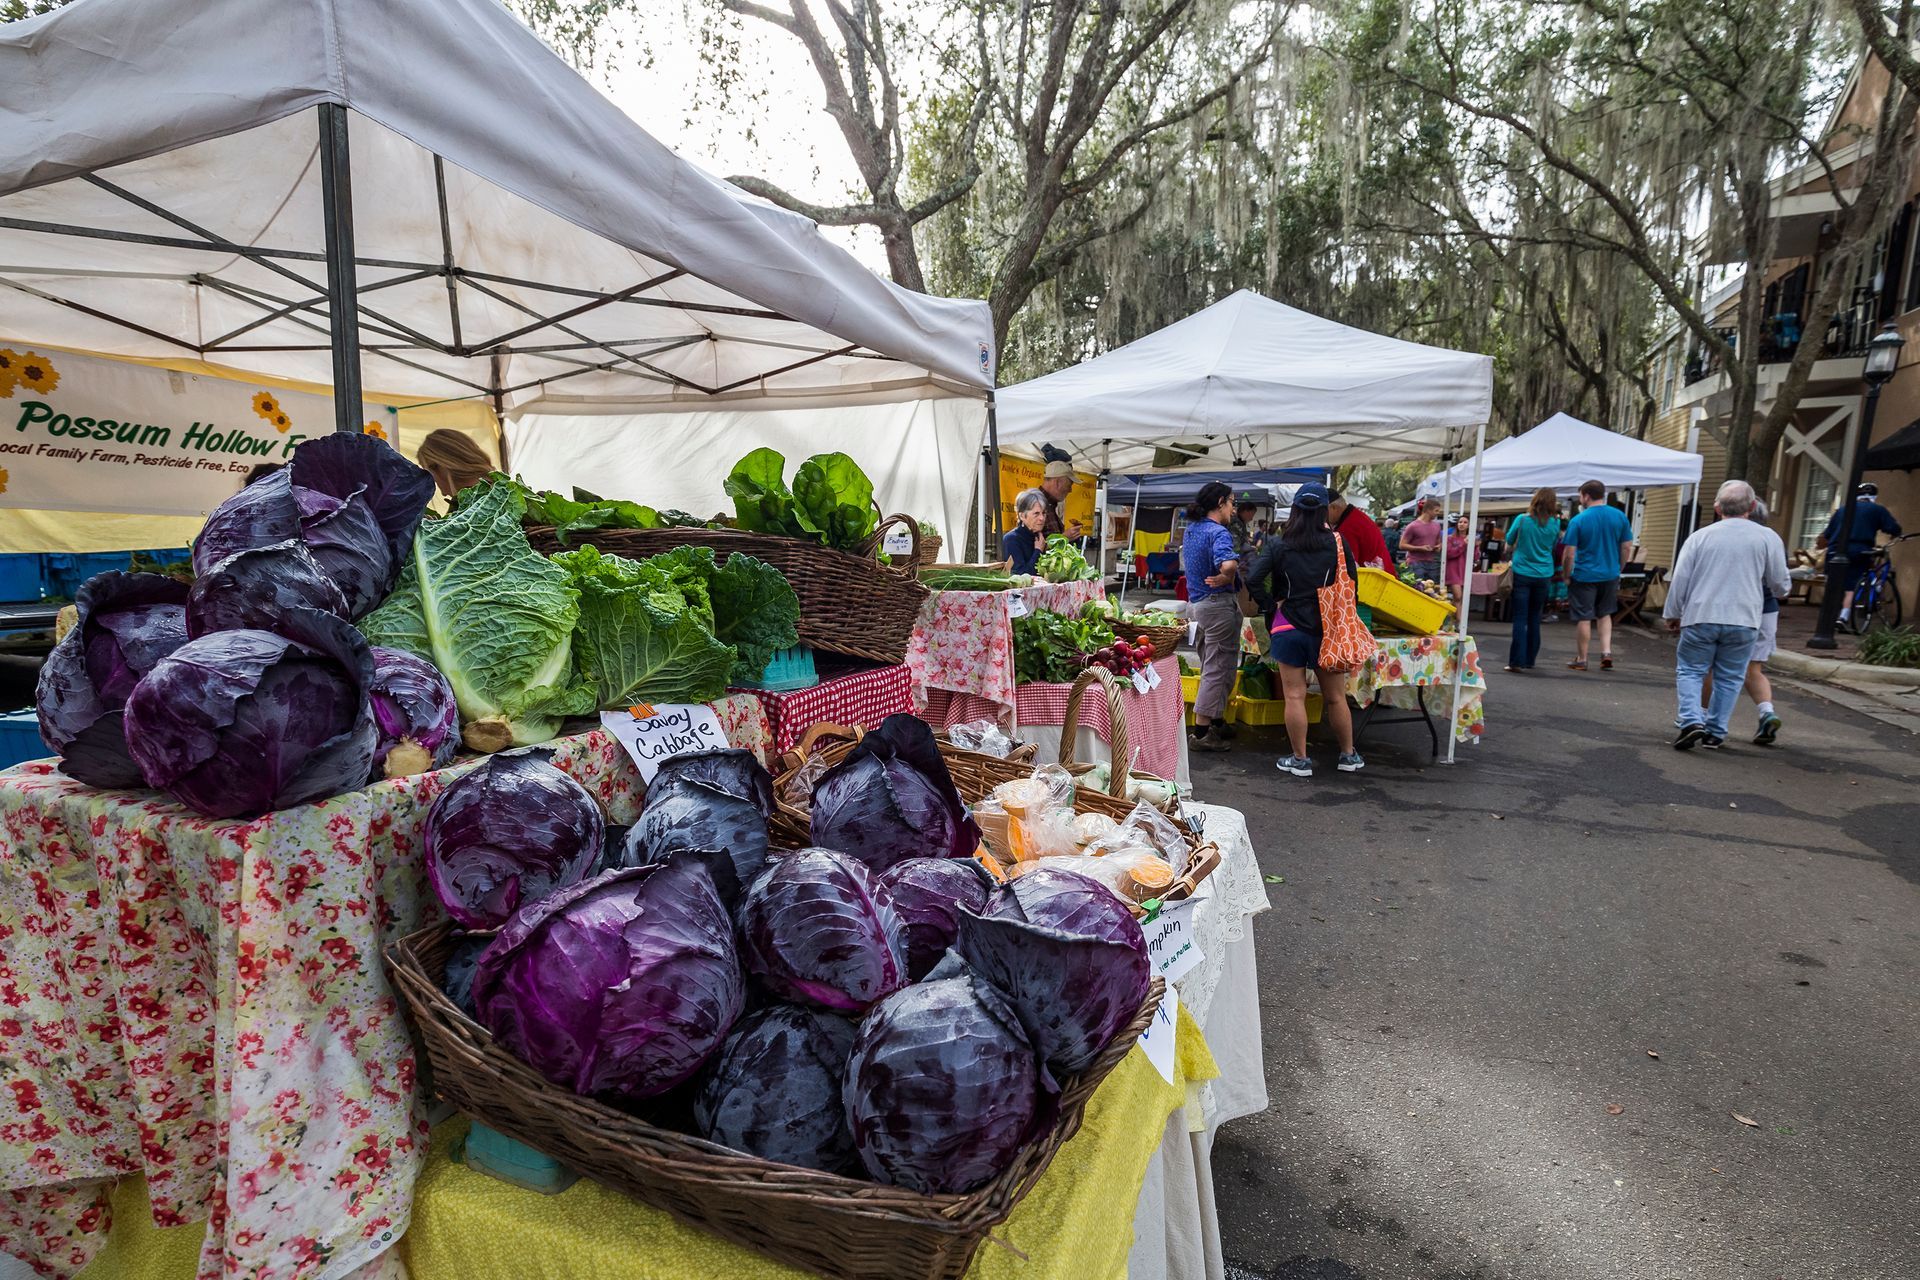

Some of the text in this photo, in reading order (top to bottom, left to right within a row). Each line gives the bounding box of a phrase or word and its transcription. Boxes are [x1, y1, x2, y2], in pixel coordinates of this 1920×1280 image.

[16, 400, 308, 459] Possum Hollow F
[0, 443, 34, 456] ocal
[36, 443, 88, 464] Family
[90, 449, 130, 465] Farm,
[133, 453, 193, 468] Pesticide
[195, 458, 225, 472] Free,
[632, 708, 692, 734] Savoy
[636, 723, 714, 760] Cabbage
[1149, 915, 1181, 956] mpkin
